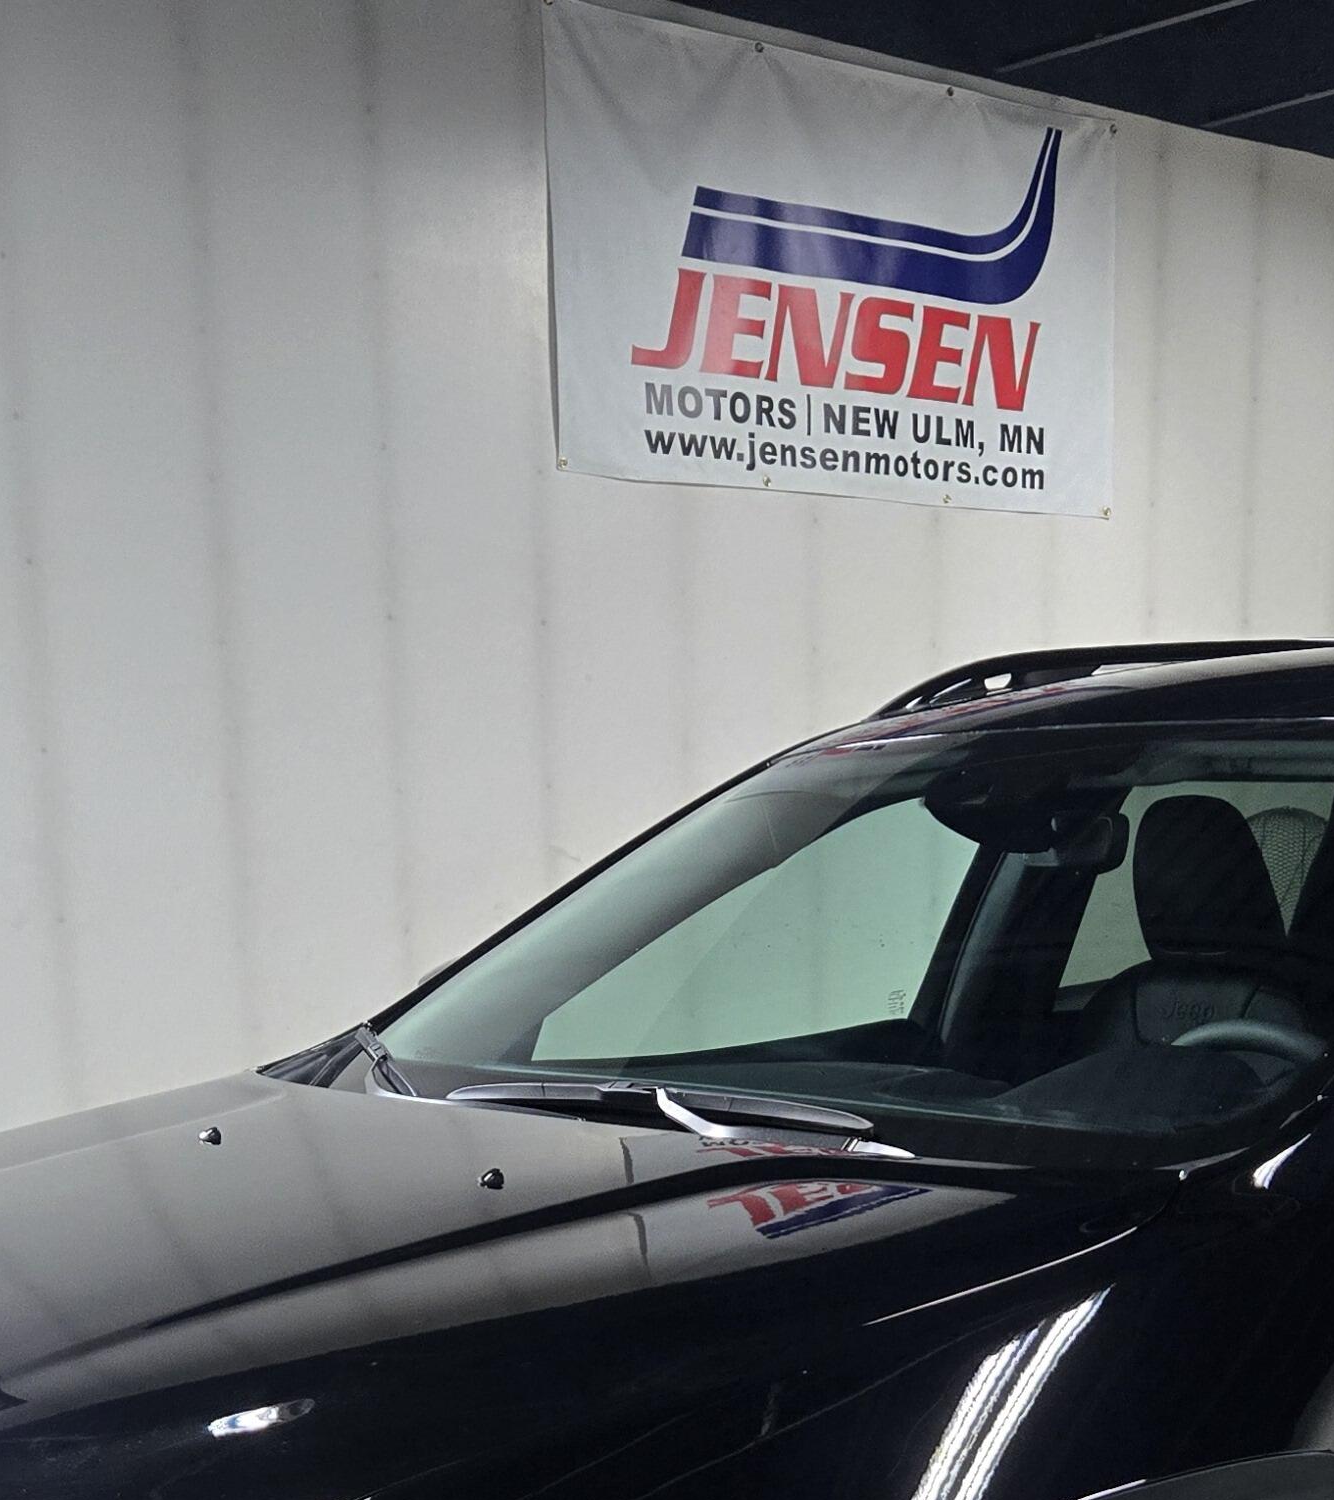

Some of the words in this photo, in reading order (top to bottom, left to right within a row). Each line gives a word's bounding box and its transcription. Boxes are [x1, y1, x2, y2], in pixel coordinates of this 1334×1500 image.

[631, 267, 1041, 412] JENSEN
[644, 382, 797, 428] MOTORS
[823, 403, 899, 440] NEW
[912, 413, 985, 456] ULM,
[999, 424, 1046, 455] MN
[645, 429, 1045, 489] www.jensenmotors.com
